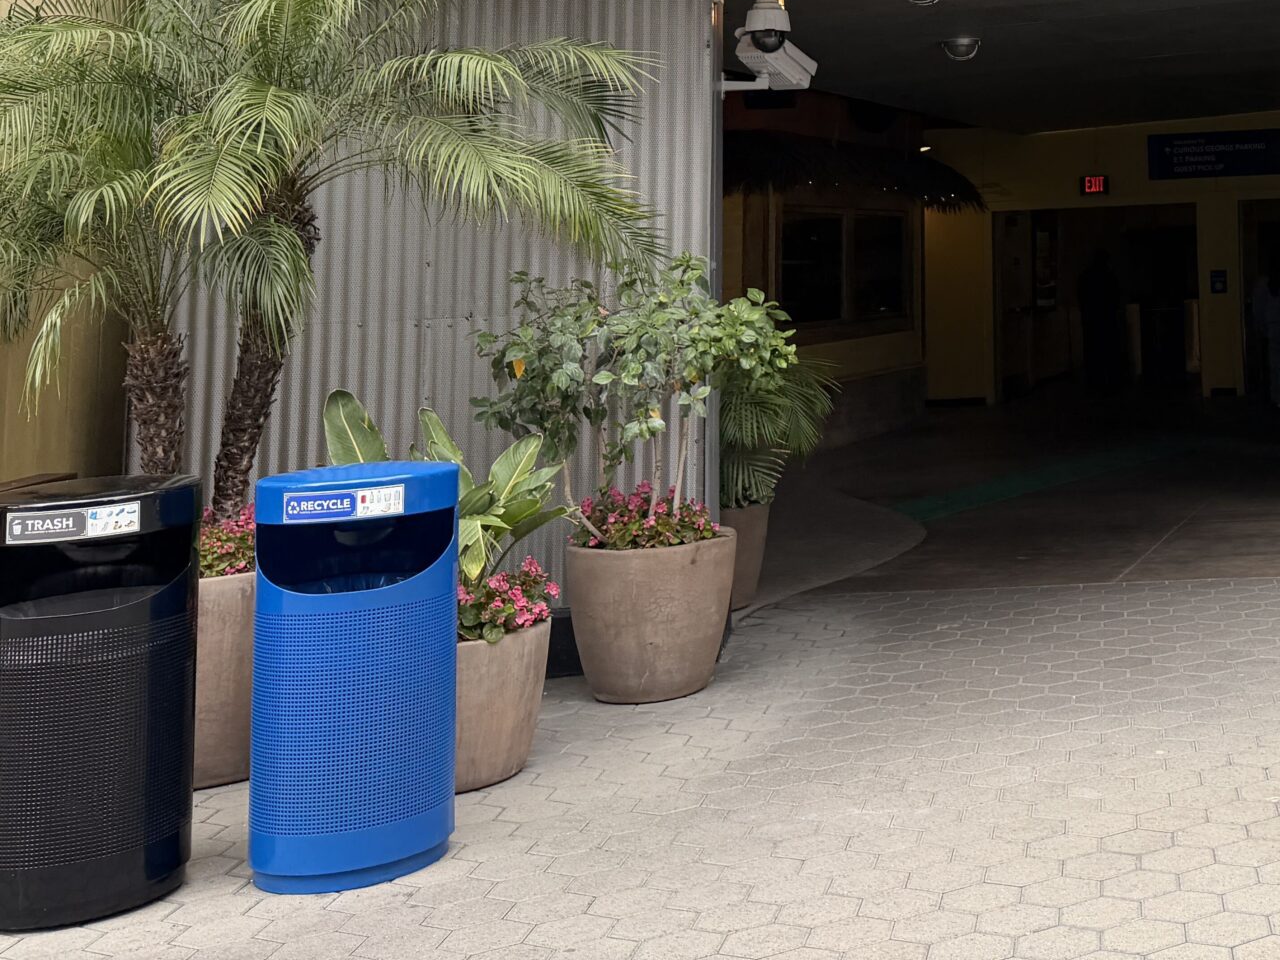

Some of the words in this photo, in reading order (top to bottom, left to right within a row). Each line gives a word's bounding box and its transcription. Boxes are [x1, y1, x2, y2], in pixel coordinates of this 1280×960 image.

[1085, 176, 1104, 193] EXIT
[300, 498, 351, 511] RECYCLE
[25, 517, 74, 531] TRASH
